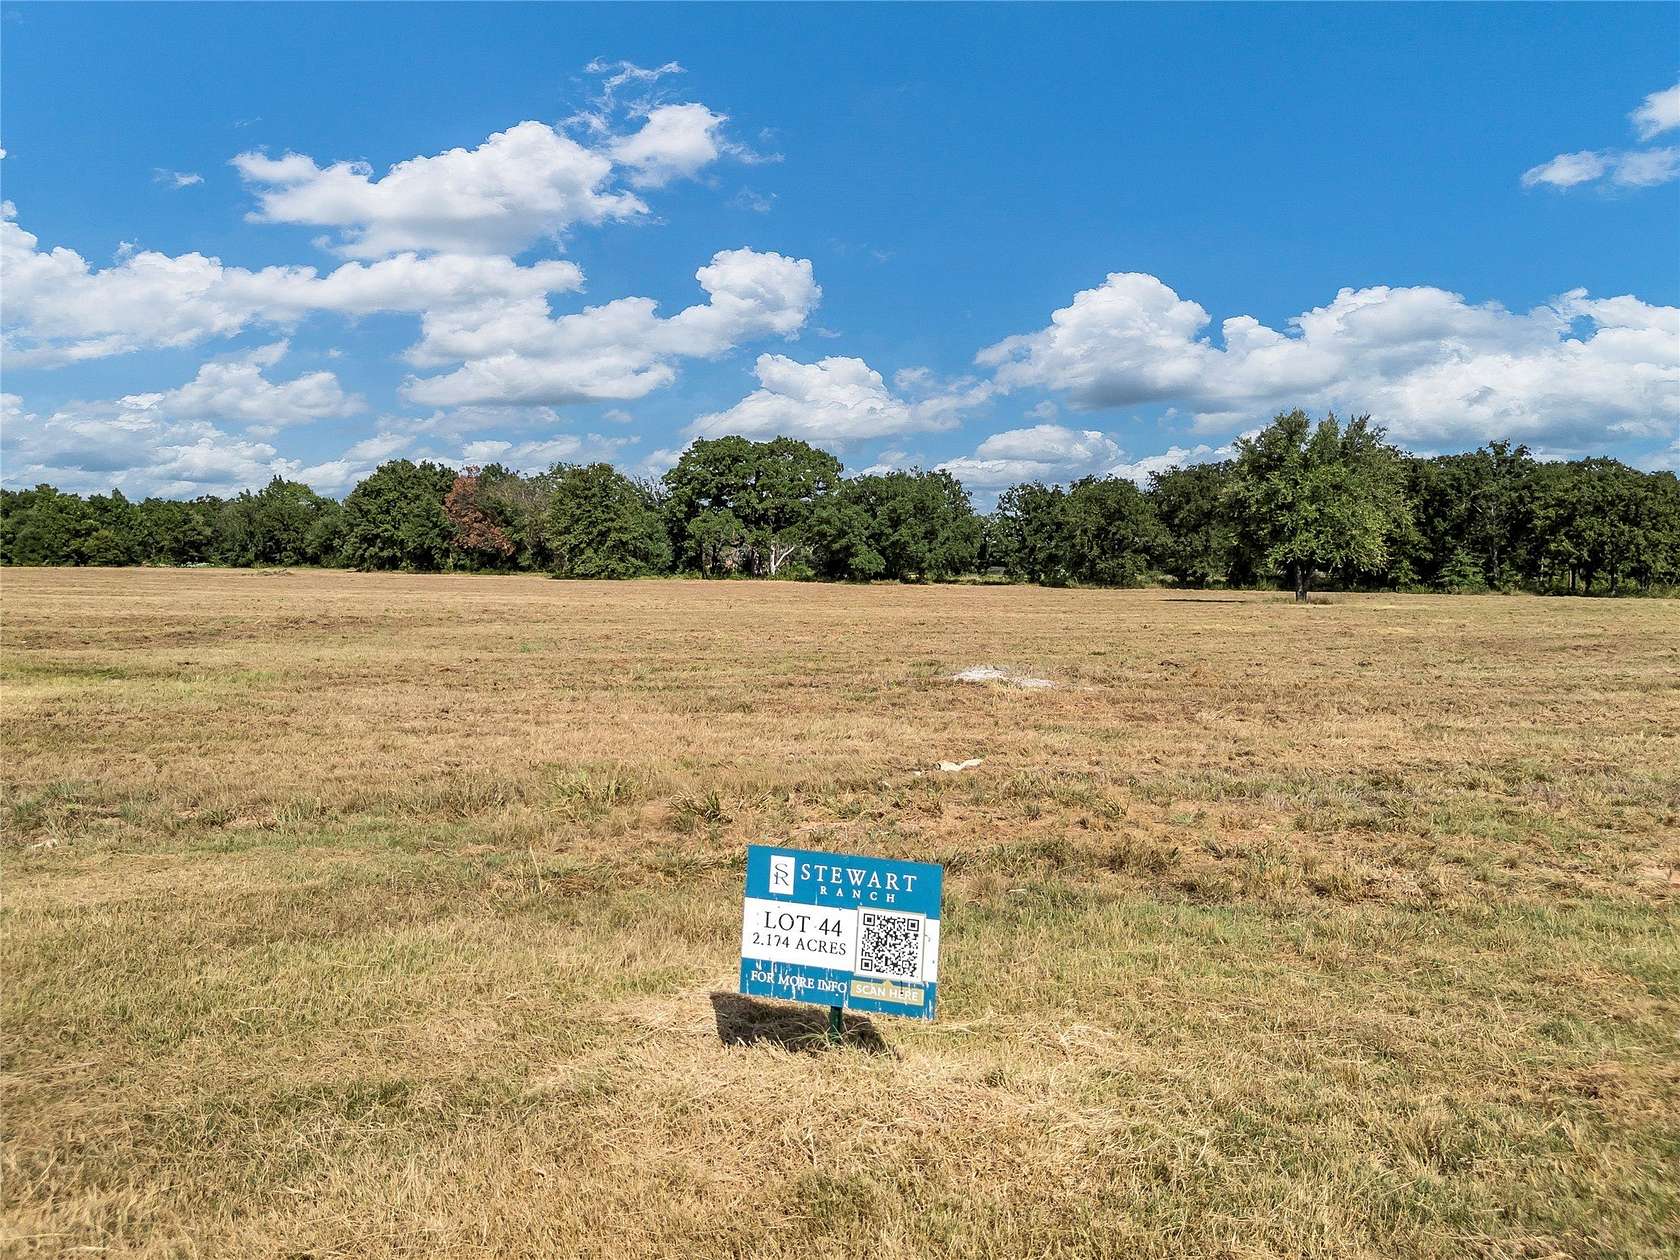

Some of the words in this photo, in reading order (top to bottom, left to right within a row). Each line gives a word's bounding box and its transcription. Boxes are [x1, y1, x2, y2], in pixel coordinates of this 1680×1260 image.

[801, 863, 917, 892] STEWART
[820, 885, 895, 903] RANCH
[764, 911, 811, 933] LOT
[819, 918, 843, 937] 44
[752, 932, 790, 949] 2.174
[795, 938, 847, 956] ACRES
[751, 970, 775, 984] FOR
[778, 974, 815, 989] MORE
[817, 979, 848, 993] INFO
[855, 984, 886, 998] SCAN
[889, 988, 918, 1001] HERE
